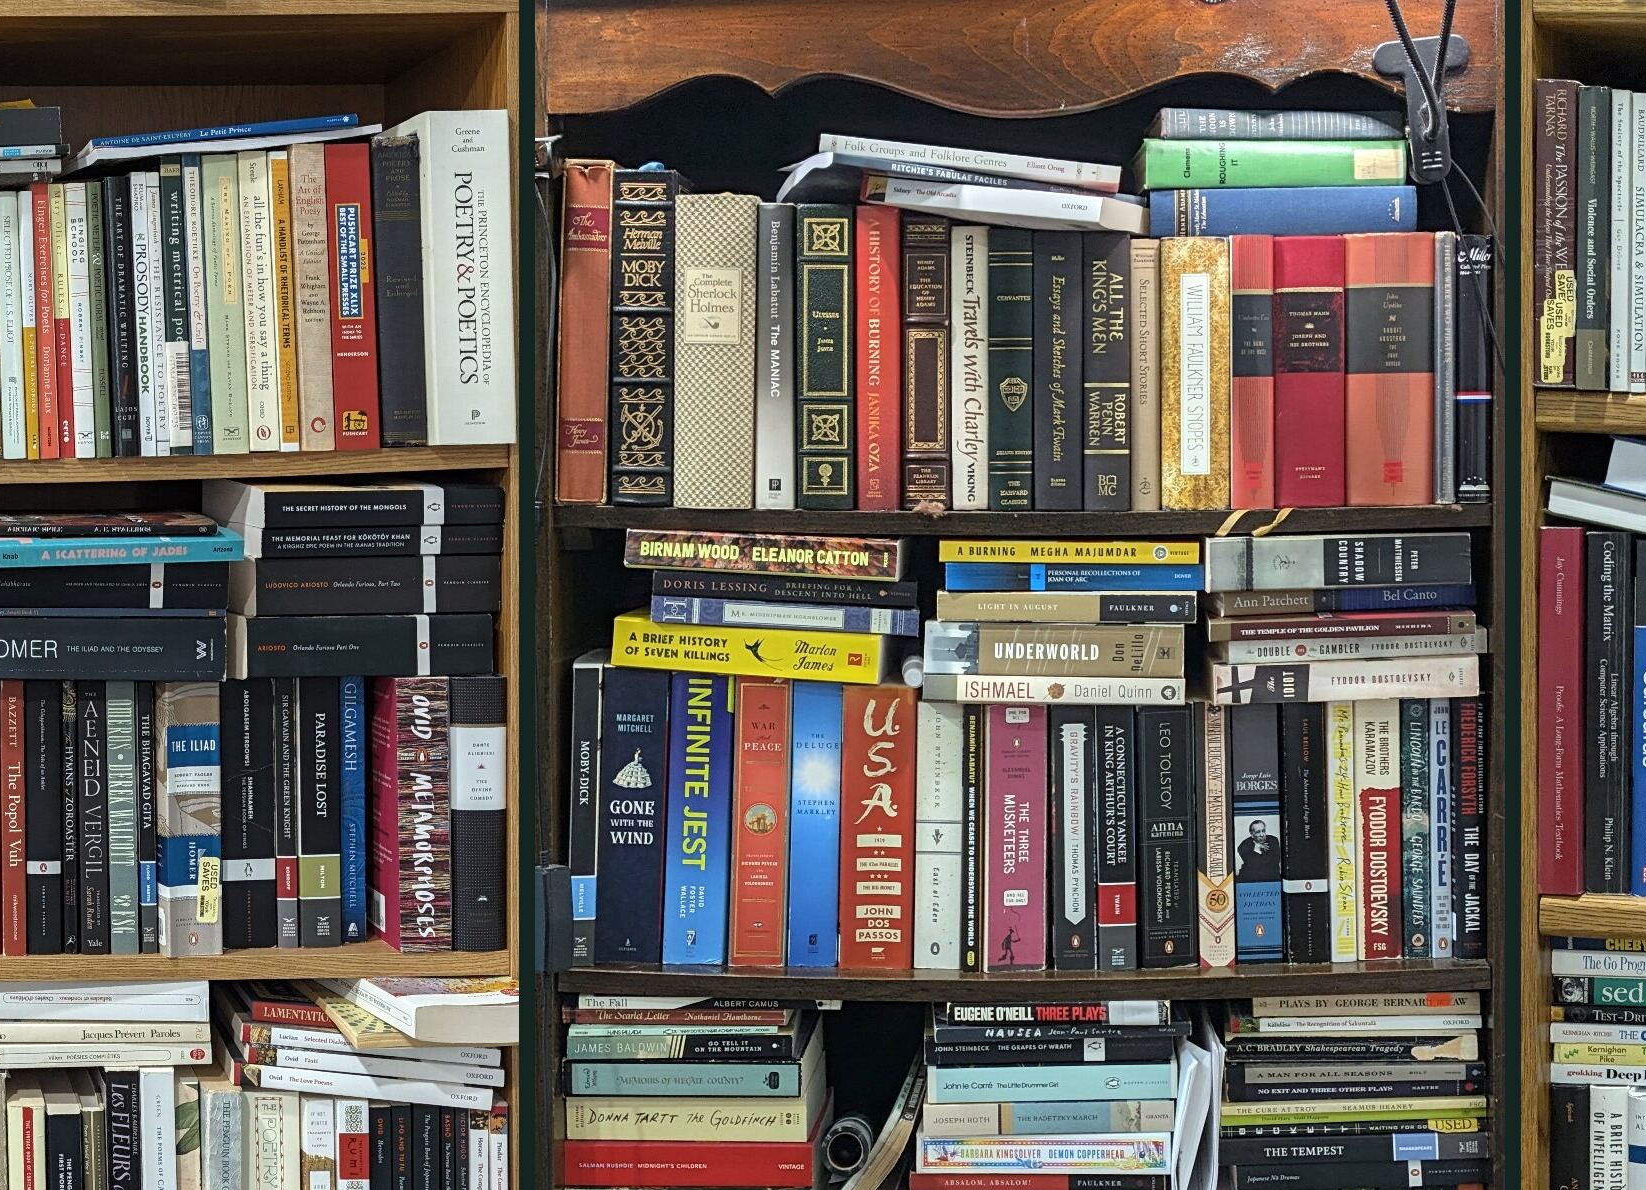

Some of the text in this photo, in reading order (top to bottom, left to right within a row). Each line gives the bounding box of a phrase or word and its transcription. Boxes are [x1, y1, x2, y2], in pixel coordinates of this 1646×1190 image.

[200, 125, 252, 137] Le Petit Prince
[455, 127, 480, 136] Greene
[452, 142, 484, 152] Cushman
[622, 260, 664, 276] MOBY
[625, 272, 661, 286] DICK
[688, 286, 737, 300] Sherlock
[690, 300, 734, 312] Holmes
[1187, 285, 1203, 416] WILLIAM FAULKNER
[640, 542, 869, 566] BIRNAM WOOD ELEANOR CATTON
[1031, 548, 1137, 557] MEGHA MAJUMDAR
[965, 682, 1035, 700] ISHMAEL
[683, 679, 711, 871] INFINITE JEST
[1236, 781, 1277, 790] BORGES
[411, 774, 435, 938] METAMORPHOSES
[1601, 984, 1643, 1003] sed
[82, 1028, 180, 1041] Jacques Prévert Paroles
[1264, 1146, 1344, 1157] THE TEMPEST
